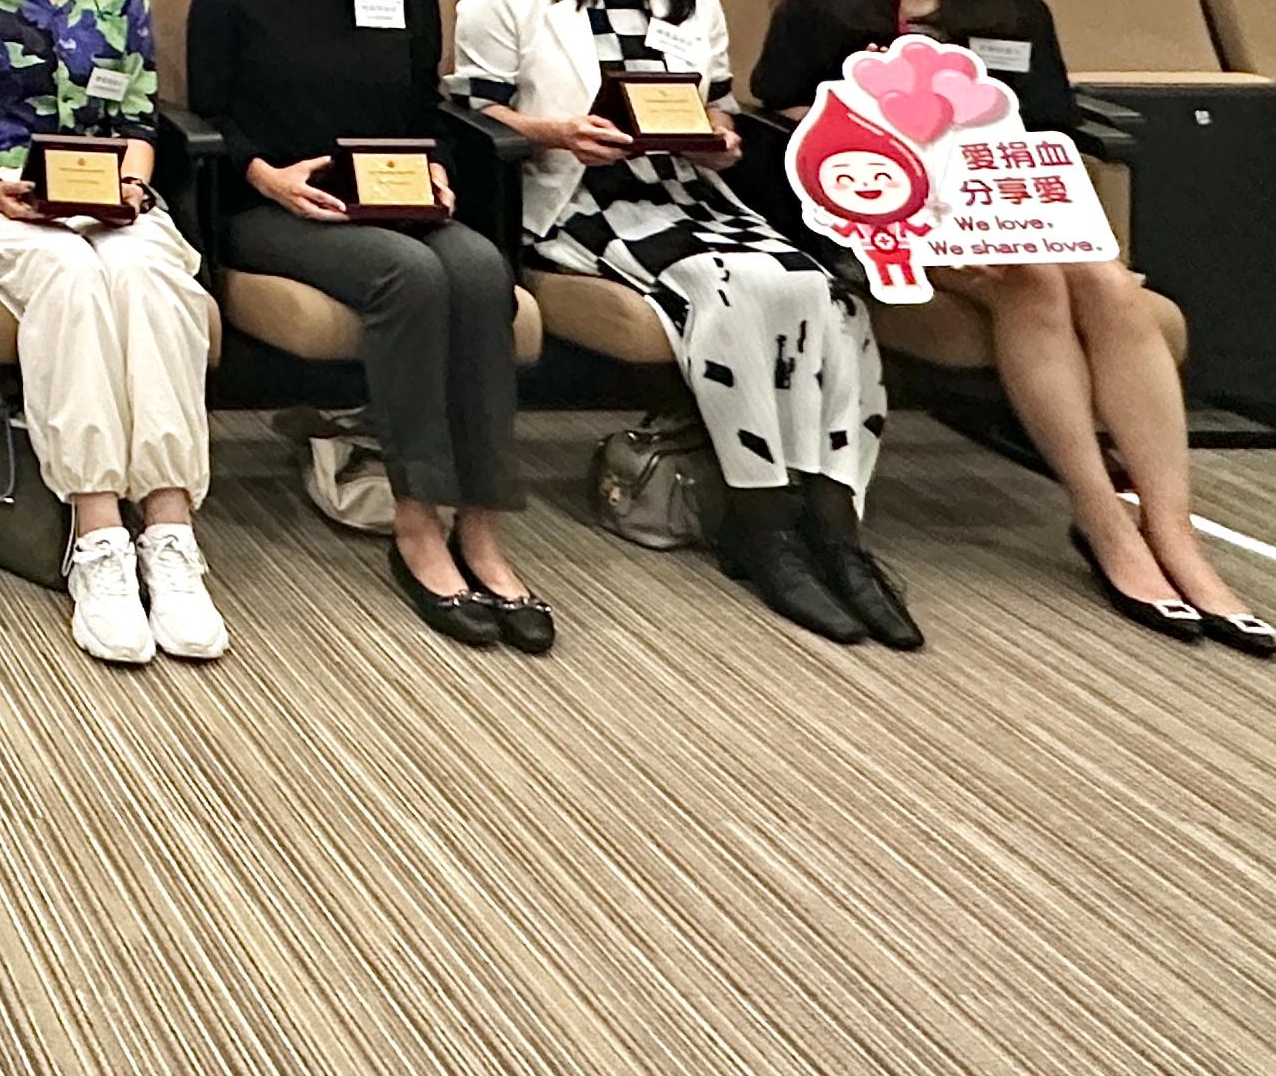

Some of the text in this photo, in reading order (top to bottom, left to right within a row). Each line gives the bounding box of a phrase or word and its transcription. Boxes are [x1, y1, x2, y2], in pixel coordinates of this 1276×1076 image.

[959, 140, 1074, 171] 愛捐血
[959, 175, 1074, 207] 分享愛
[954, 216, 990, 231] We
[928, 240, 964, 255] We
[971, 239, 1038, 255] share
